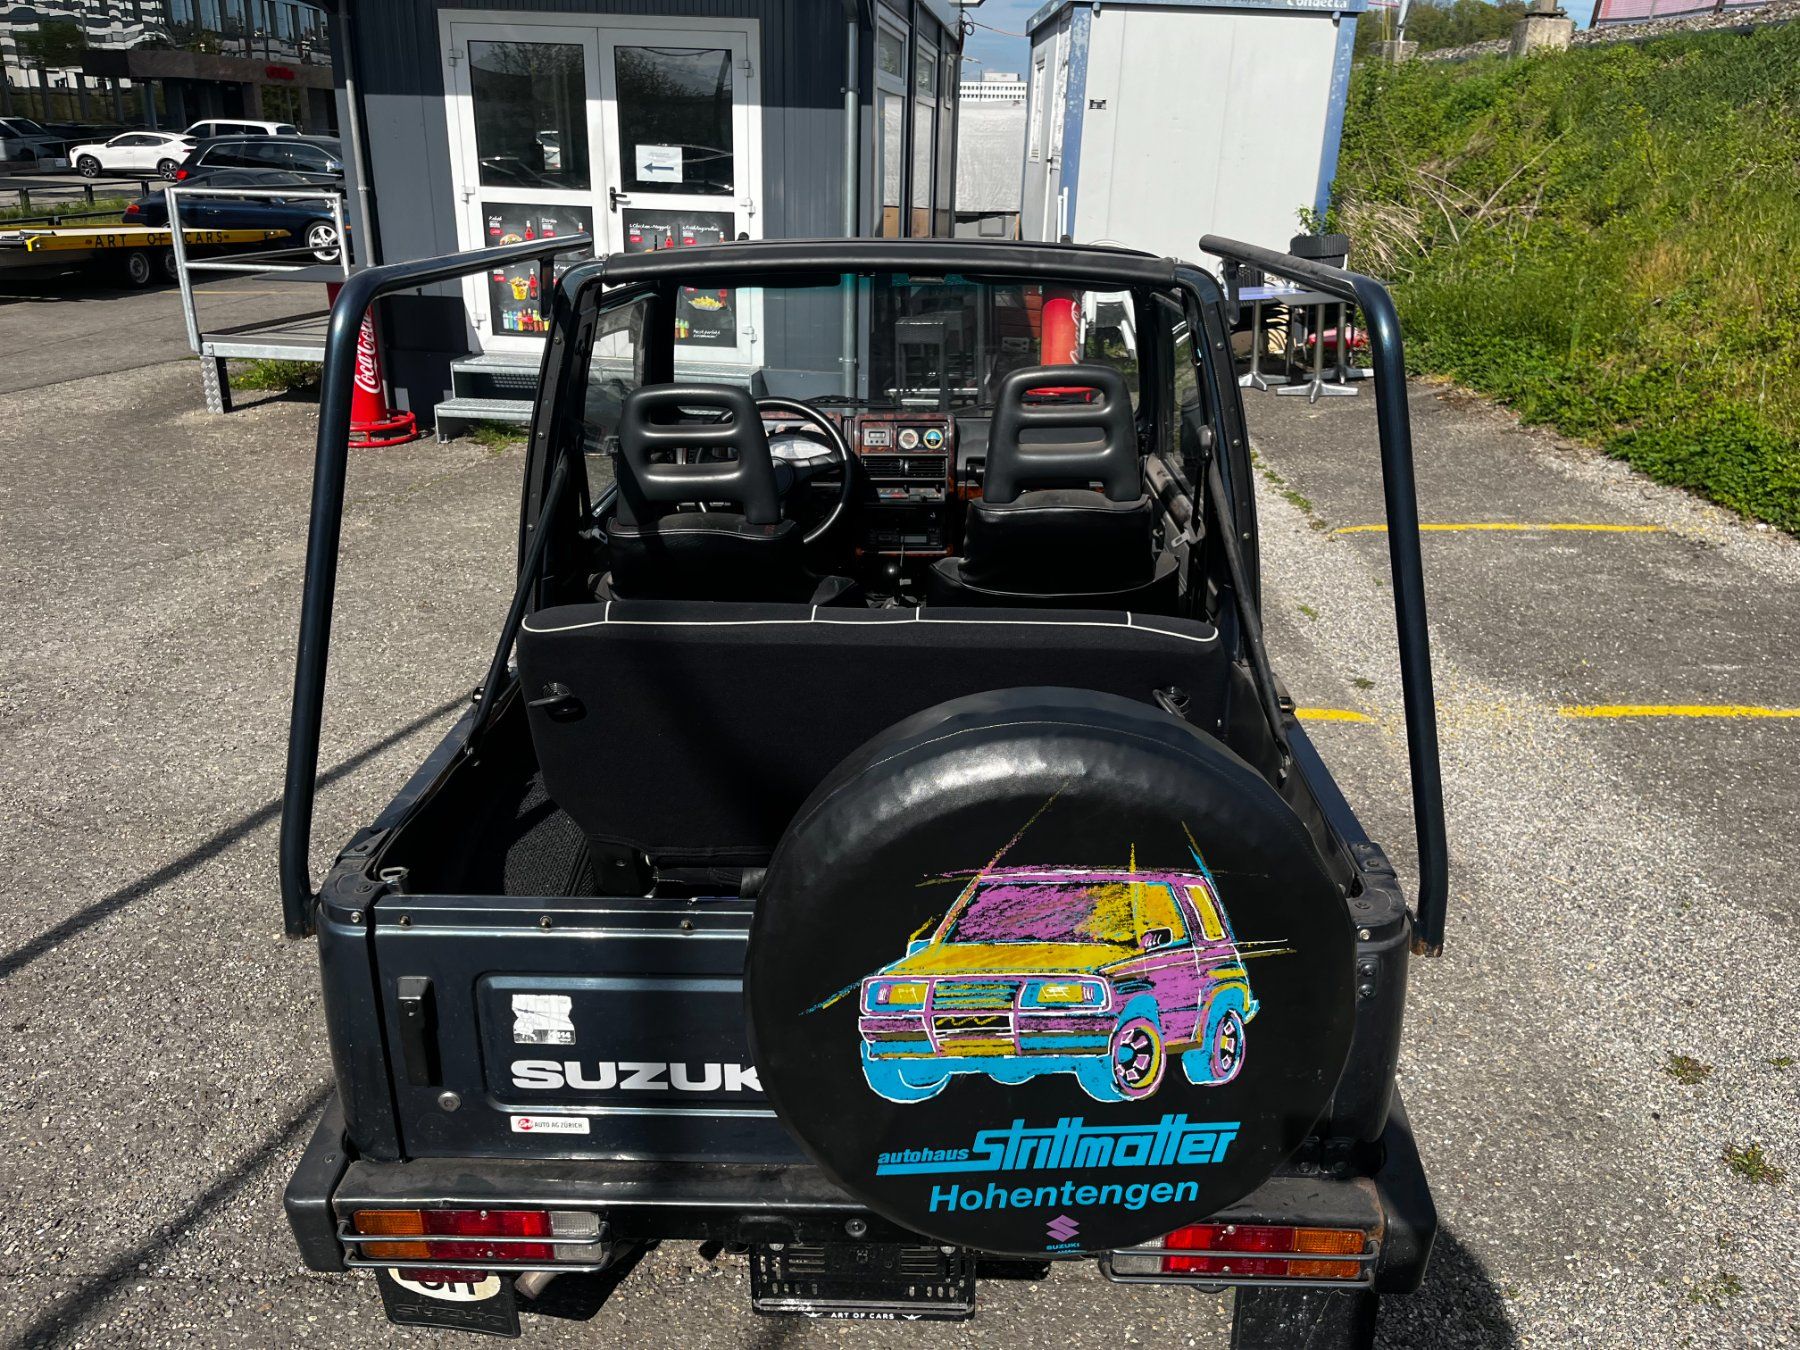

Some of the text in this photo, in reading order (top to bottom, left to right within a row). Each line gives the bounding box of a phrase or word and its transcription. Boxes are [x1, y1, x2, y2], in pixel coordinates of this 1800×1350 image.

[95, 231, 224, 248] ART OF CARS
[510, 1060, 764, 1092] SUZUK
[877, 1113, 1241, 1170] autohaus Strittmatter
[928, 1180, 1199, 1212] Hohentengen
[1046, 1242, 1080, 1250] SUZUKI
[852, 1312, 866, 1320] OF
[869, 1312, 895, 1320] CARS
